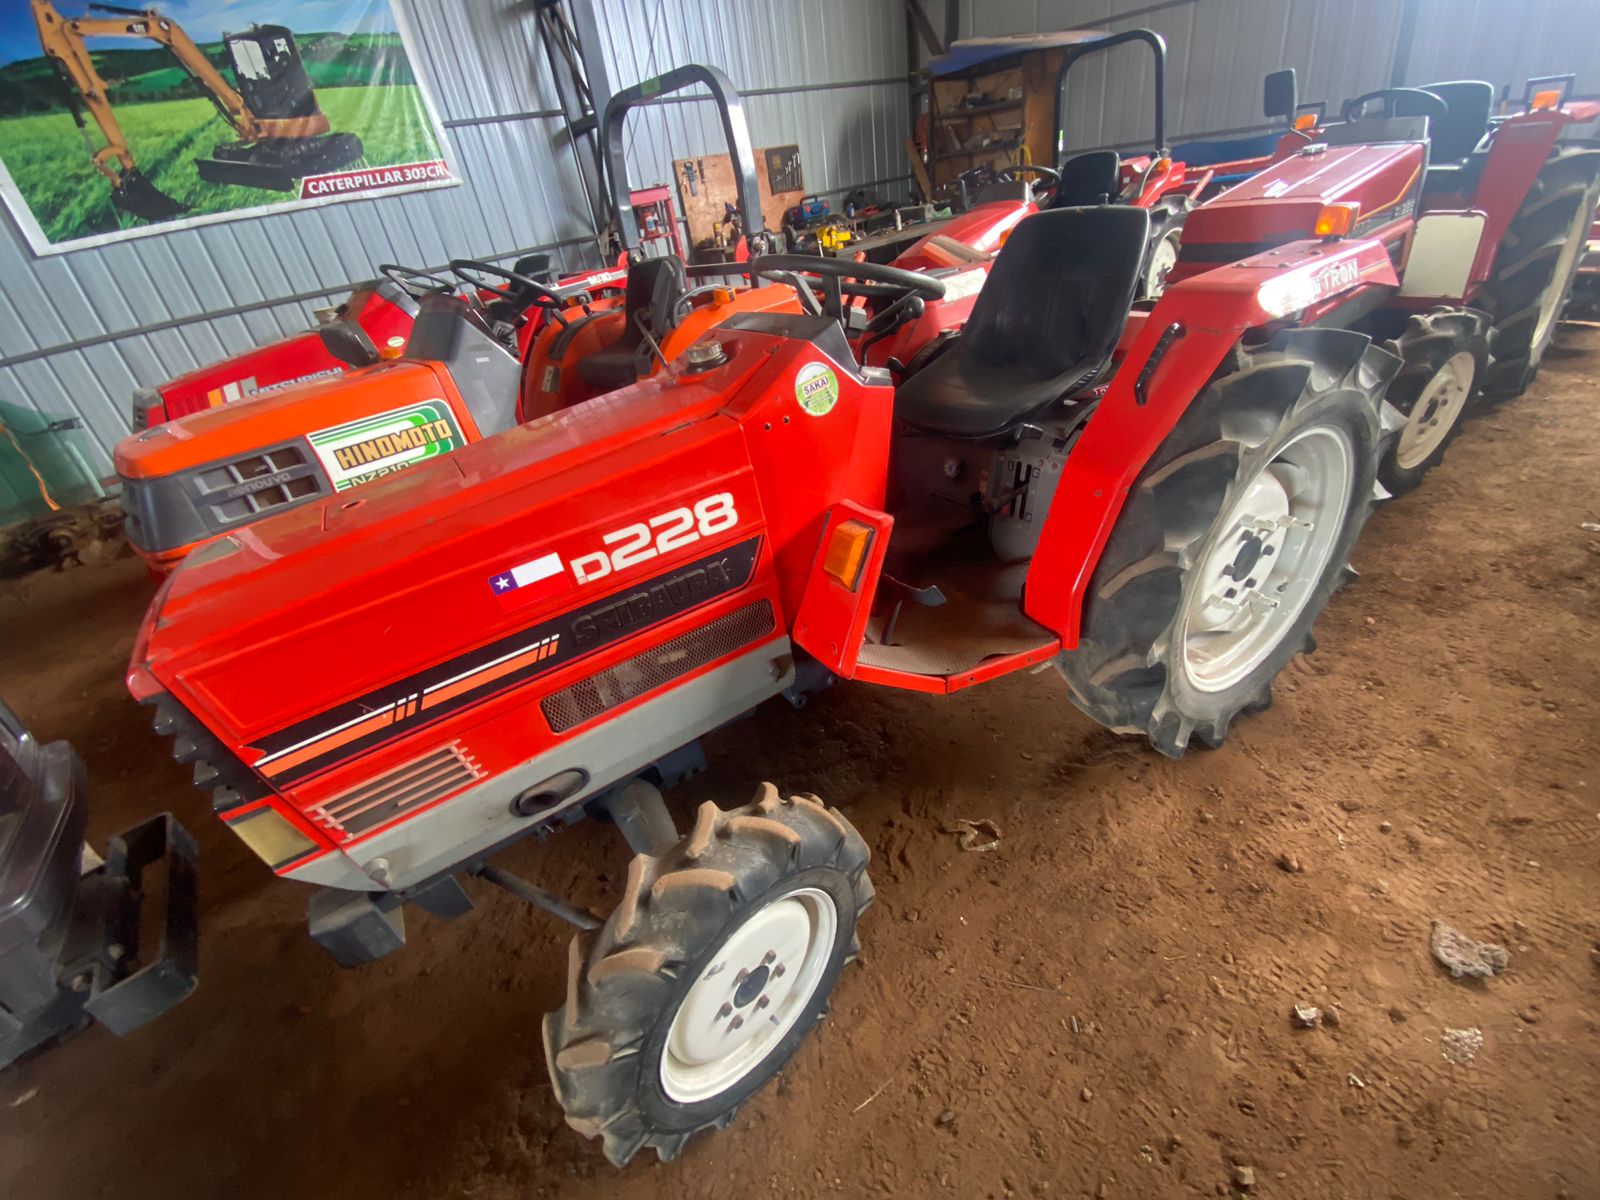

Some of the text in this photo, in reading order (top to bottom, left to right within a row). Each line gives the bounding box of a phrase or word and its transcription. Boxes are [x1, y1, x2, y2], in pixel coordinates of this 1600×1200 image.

[308, 171, 403, 194] CATERPILLAR
[803, 376, 829, 395] SAKAI
[333, 419, 453, 471] HINOMOTO
[570, 492, 738, 586] D228
[571, 561, 730, 645] SHIBAURA
